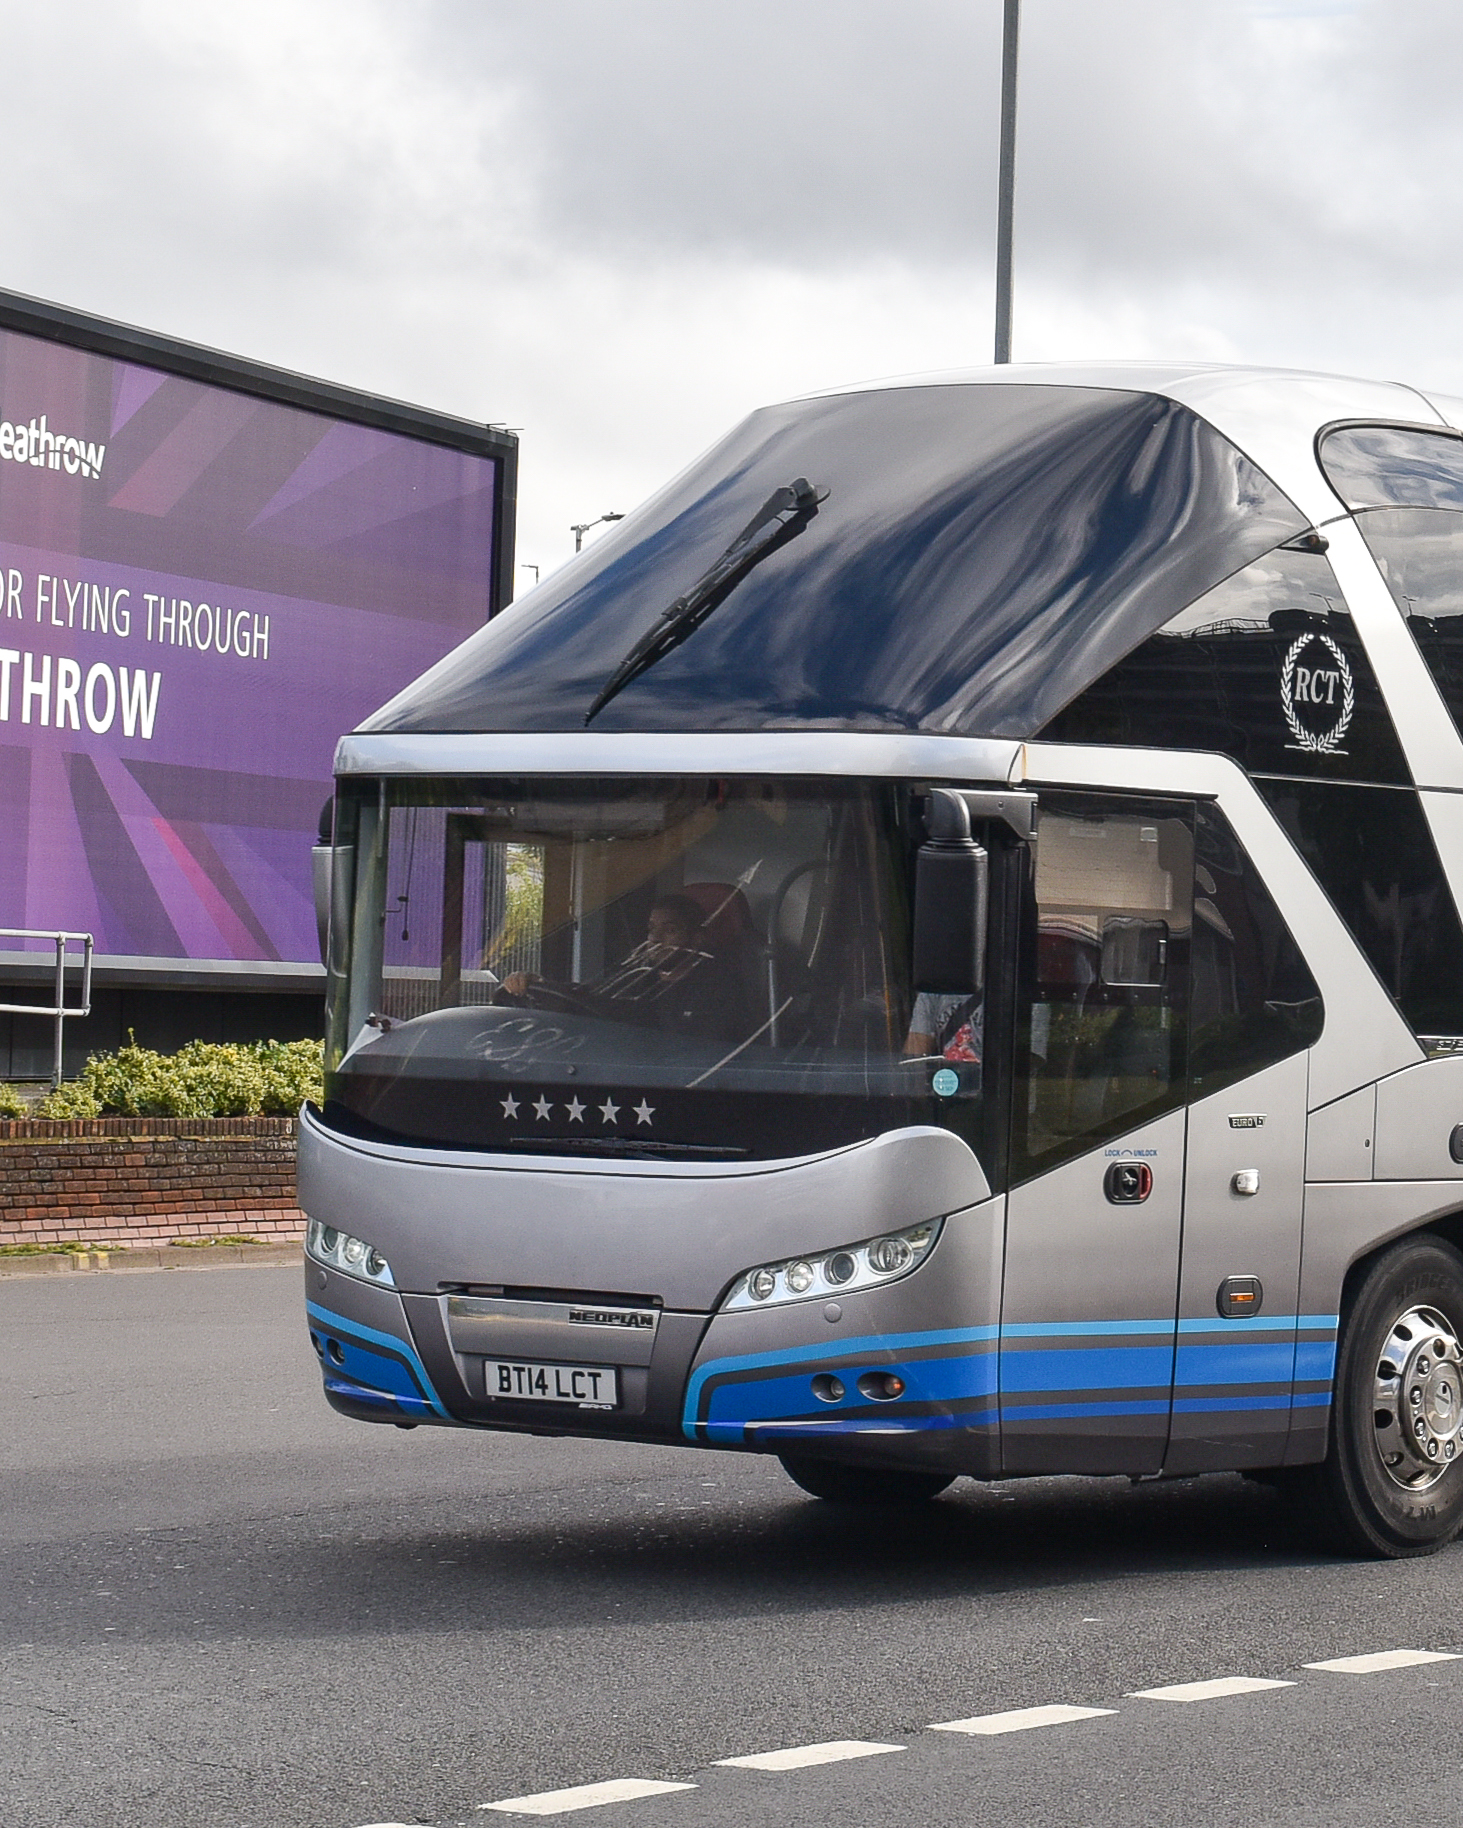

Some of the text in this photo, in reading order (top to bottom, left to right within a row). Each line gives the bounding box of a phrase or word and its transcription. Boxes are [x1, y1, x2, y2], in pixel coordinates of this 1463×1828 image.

[0, 414, 106, 480] eathrow
[0, 567, 270, 660] R FLYING THROUGH
[0, 648, 162, 740] THROW
[1294, 667, 1340, 705] RCT
[1231, 1117, 1253, 1127] EURO
[1104, 1149, 1158, 1157] LOCK UNLOCK
[568, 1310, 654, 1329] NEOPLAN
[498, 1364, 602, 1400] BT14 LCT
